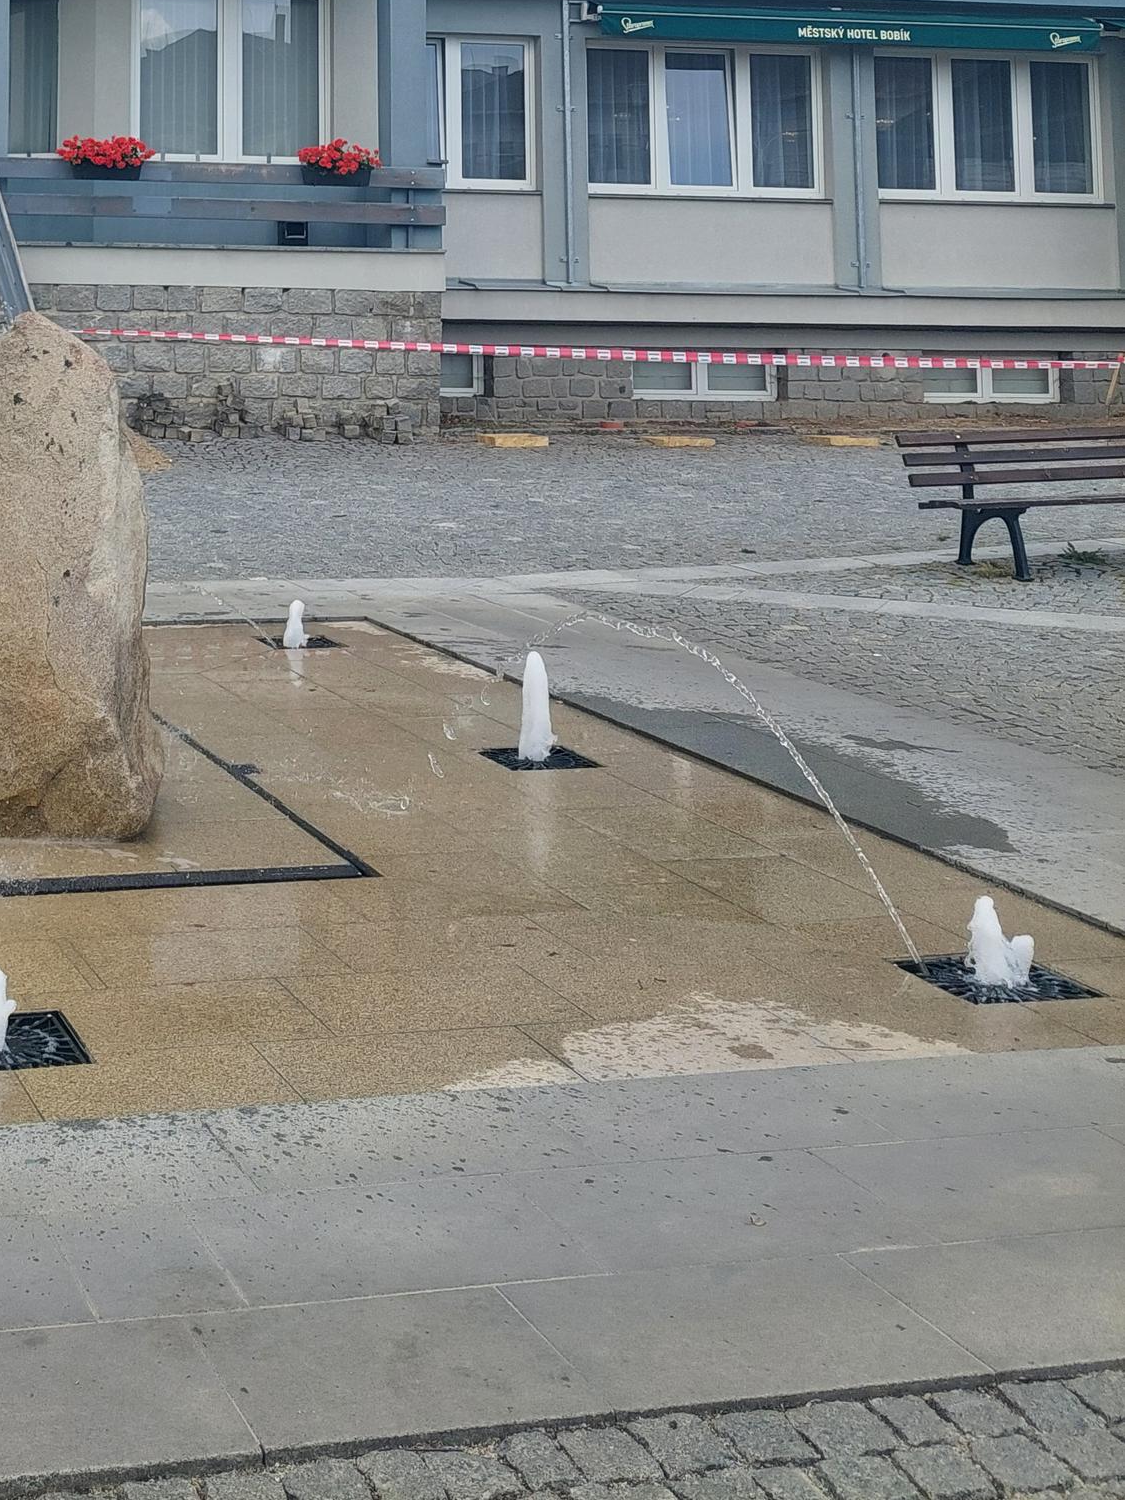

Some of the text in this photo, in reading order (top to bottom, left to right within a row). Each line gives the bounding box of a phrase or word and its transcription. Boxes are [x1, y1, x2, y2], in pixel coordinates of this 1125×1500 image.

[797, 25, 911, 41] MĚSTSKÝ HOTEL BOBÍK
